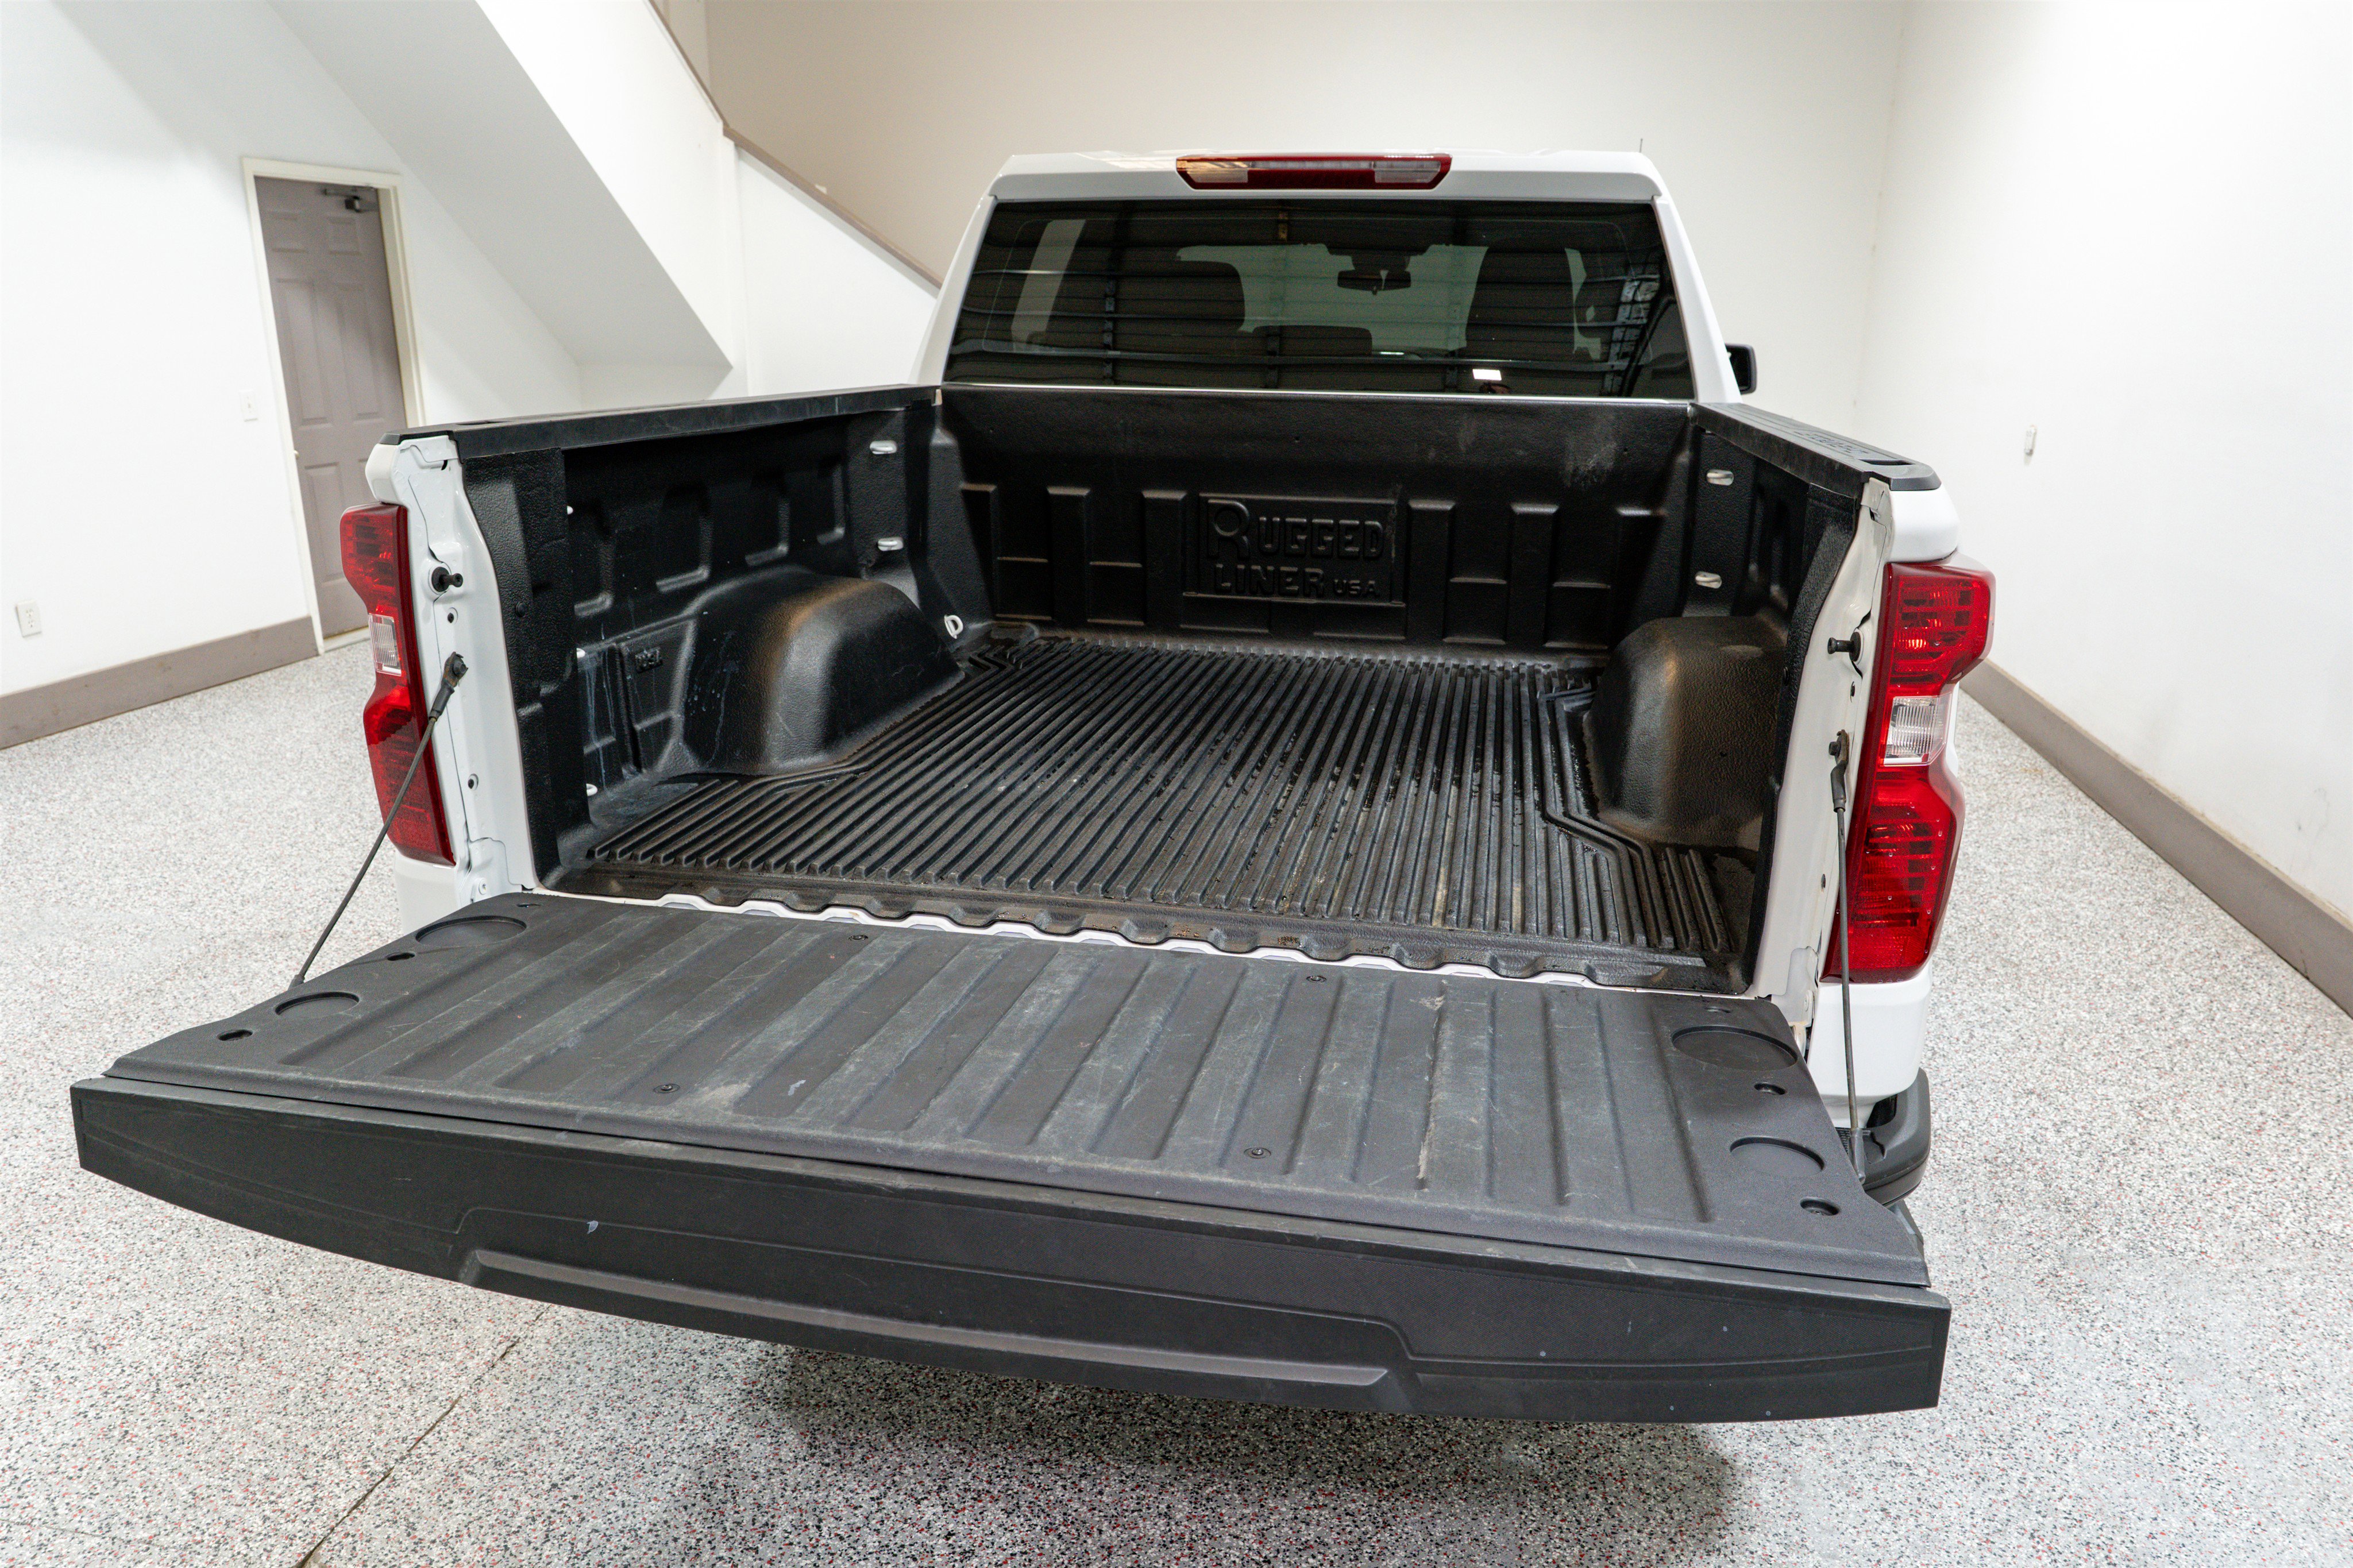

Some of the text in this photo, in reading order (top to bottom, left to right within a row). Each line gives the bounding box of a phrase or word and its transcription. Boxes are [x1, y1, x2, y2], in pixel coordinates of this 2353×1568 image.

[1208, 499, 1384, 559] RUGGED
[1214, 563, 1380, 597] LINER USA
